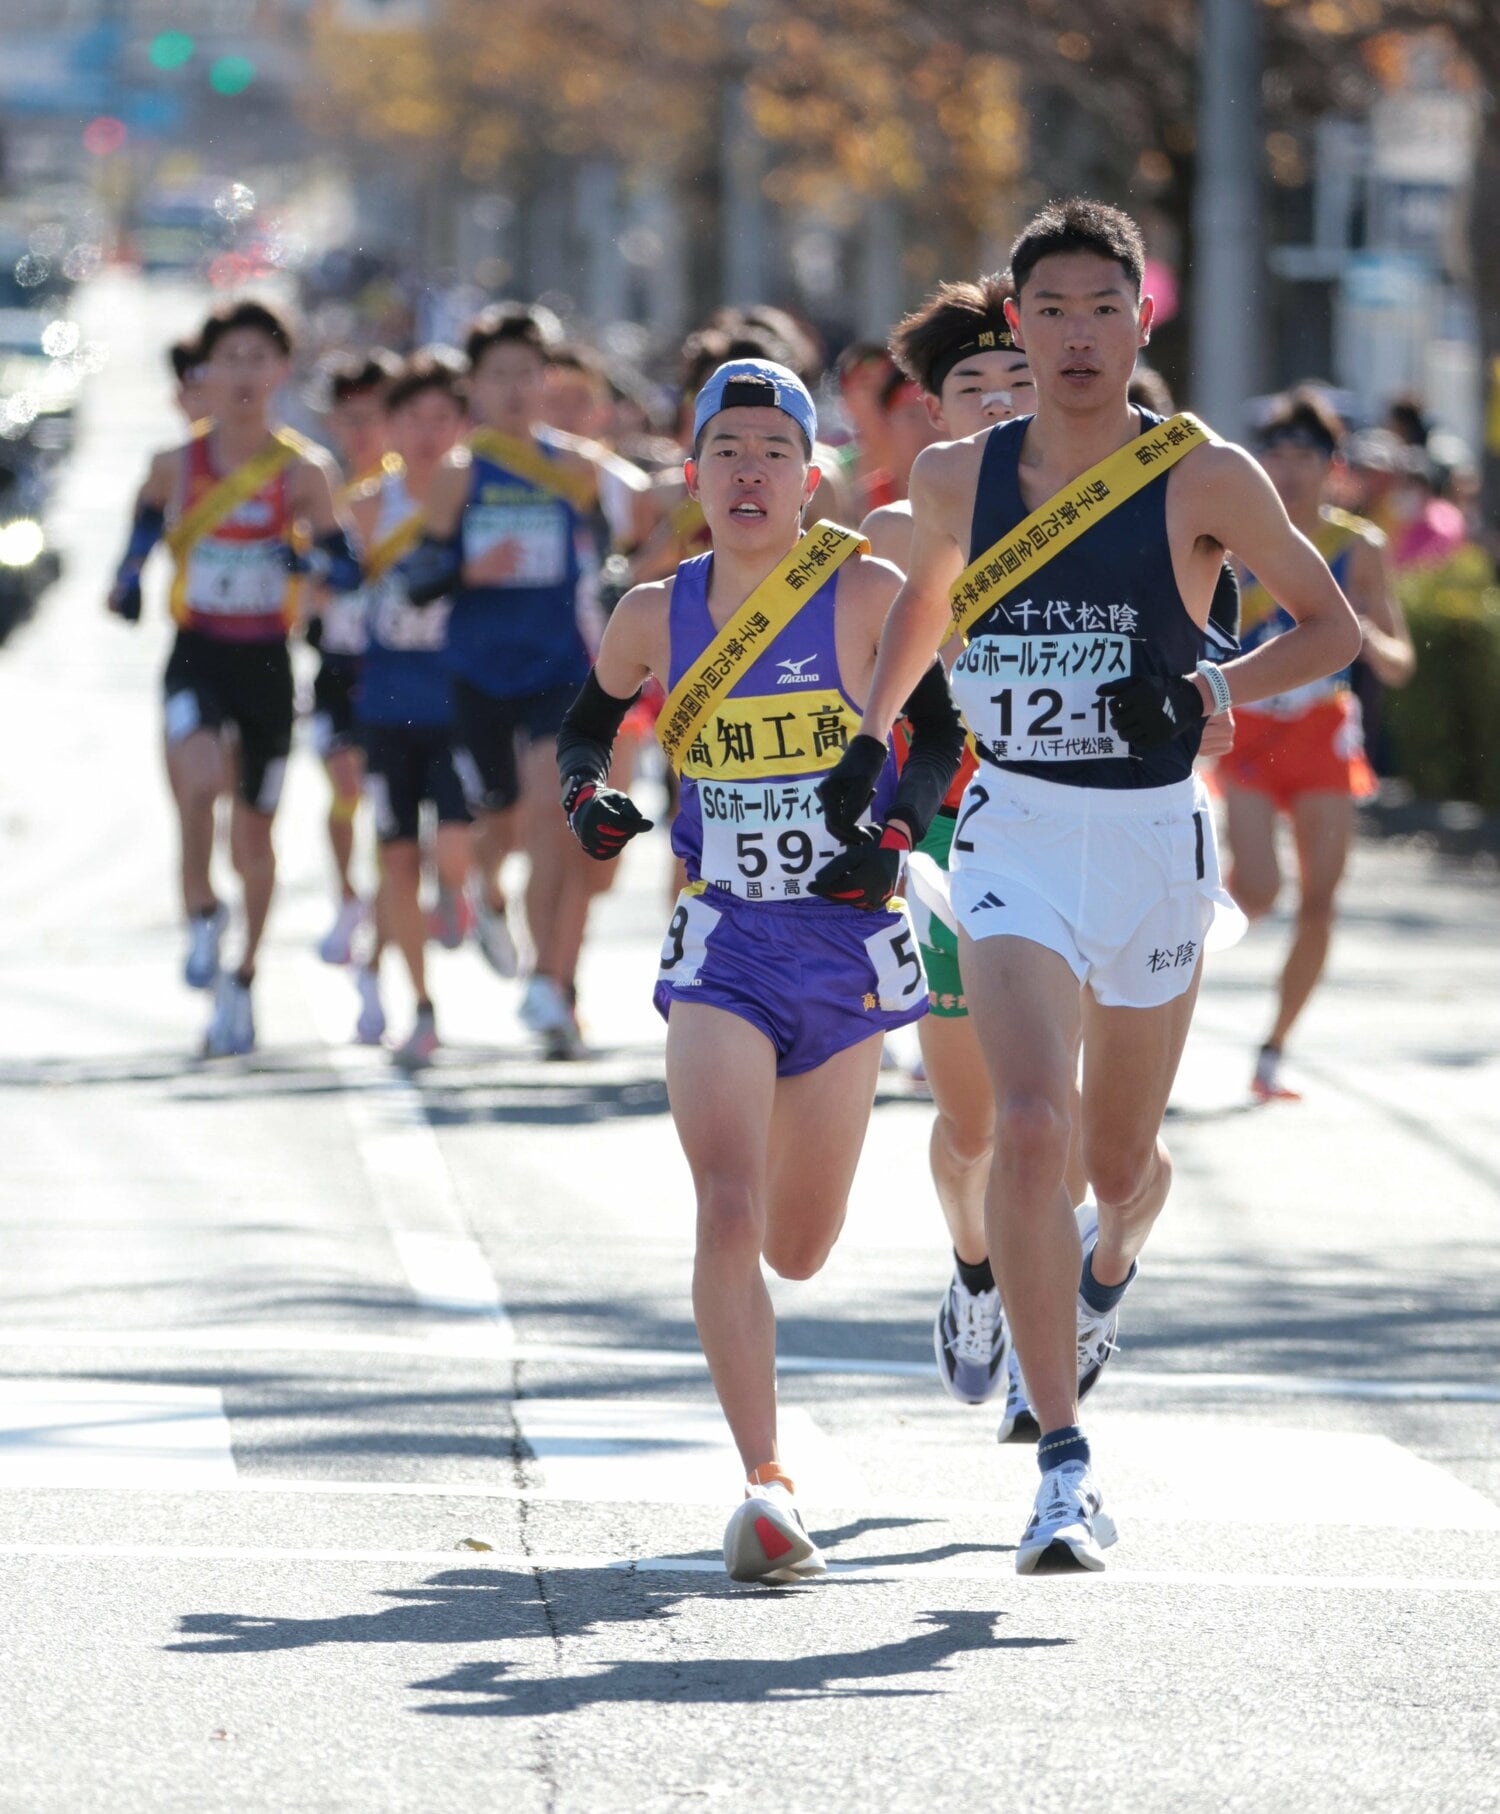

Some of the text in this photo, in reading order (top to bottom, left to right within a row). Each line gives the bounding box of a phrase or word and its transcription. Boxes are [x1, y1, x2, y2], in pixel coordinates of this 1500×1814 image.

[989, 598, 1139, 634] 八千代松陰
[776, 673, 820, 684] MIZUNO
[686, 704, 850, 768] 高知工高
[990, 687, 1107, 737] 12-1
[954, 784, 990, 853] 2
[1192, 811, 1205, 881] 1
[660, 906, 689, 970] 9
[890, 931, 922, 996] 5
[1146, 940, 1198, 974] 松陰
